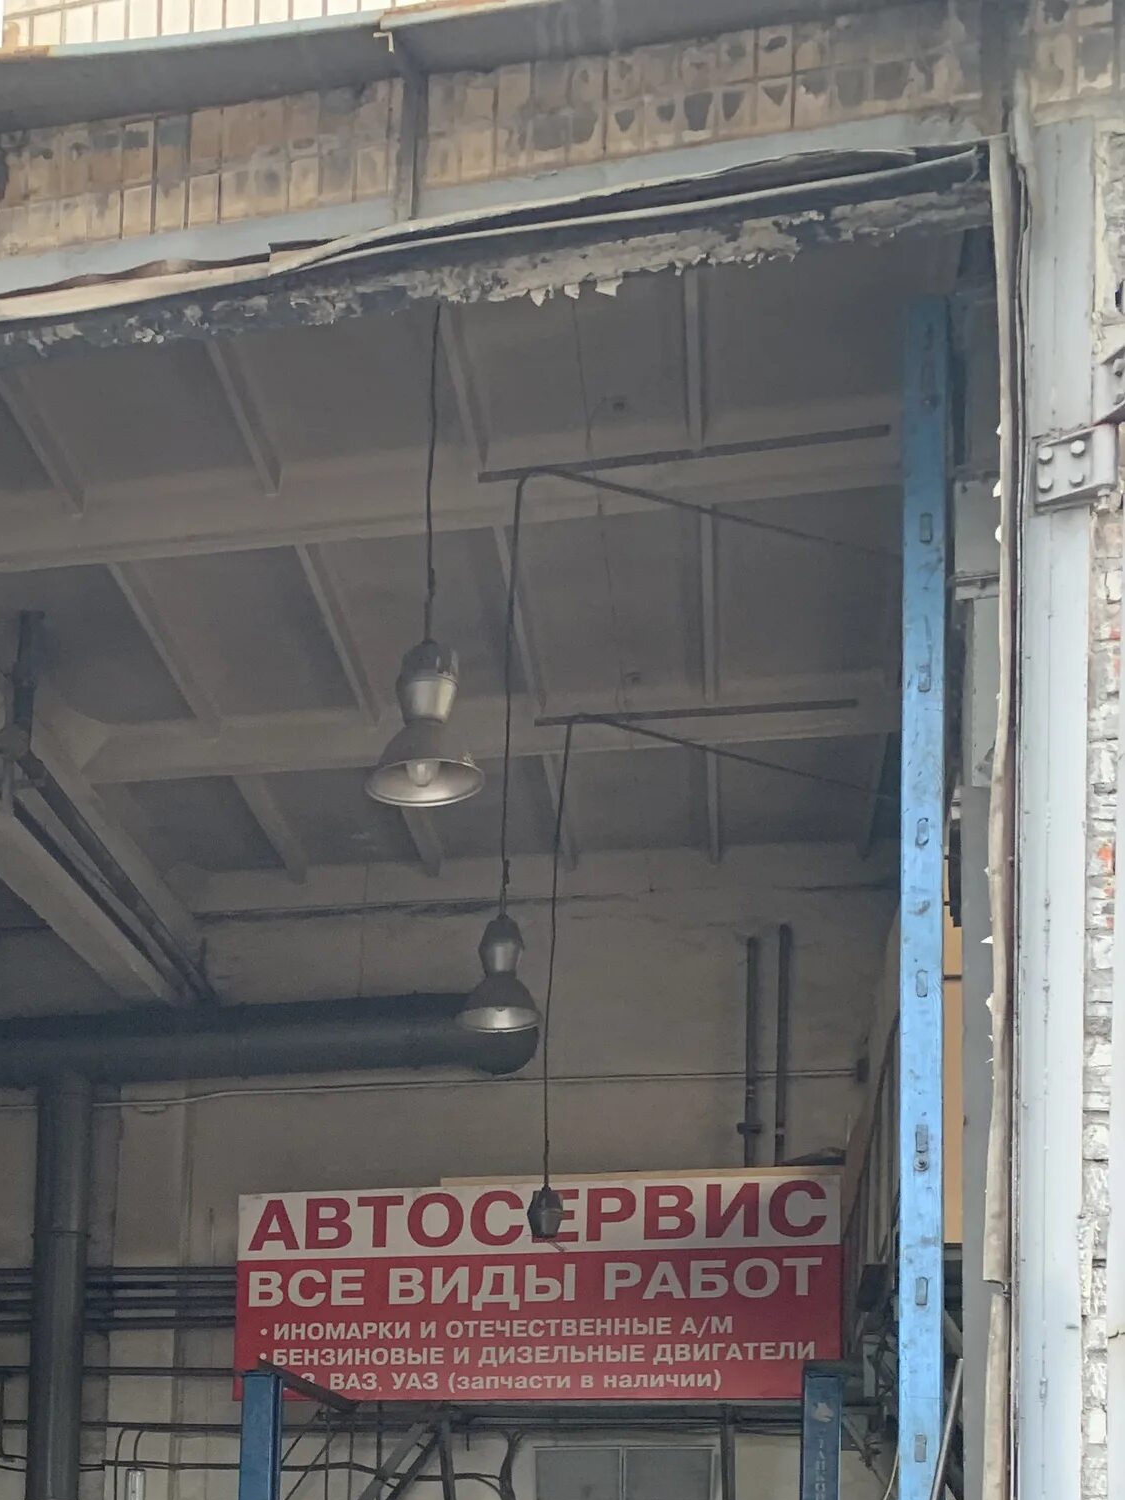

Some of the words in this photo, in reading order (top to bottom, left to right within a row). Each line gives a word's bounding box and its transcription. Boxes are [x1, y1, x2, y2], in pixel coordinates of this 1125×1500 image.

[248, 1268, 365, 1307] ВСЕ
[388, 1263, 576, 1311] ВИДЫ
[604, 1257, 823, 1300] РАБОТ
[273, 1322, 411, 1340] ИНОМАРКИ
[420, 1321, 437, 1338] И
[445, 1317, 672, 1338] ОТЕЧЕСТВЕННЫЕ
[680, 1316, 733, 1338] А/М
[272, 1347, 444, 1366] БЕНЗИНОВЫЕ
[453, 1347, 470, 1364] И
[478, 1344, 645, 1368] ДИЗЕЛЬНЫЕ
[653, 1341, 815, 1365] ДВИГАТЕЛИ
[330, 1373, 382, 1391] ВАЗ,
[391, 1372, 439, 1390] УАЗ
[448, 1372, 571, 1393] (запчасти
[581, 1375, 593, 1389] в
[603, 1370, 722, 1391] наличии)
